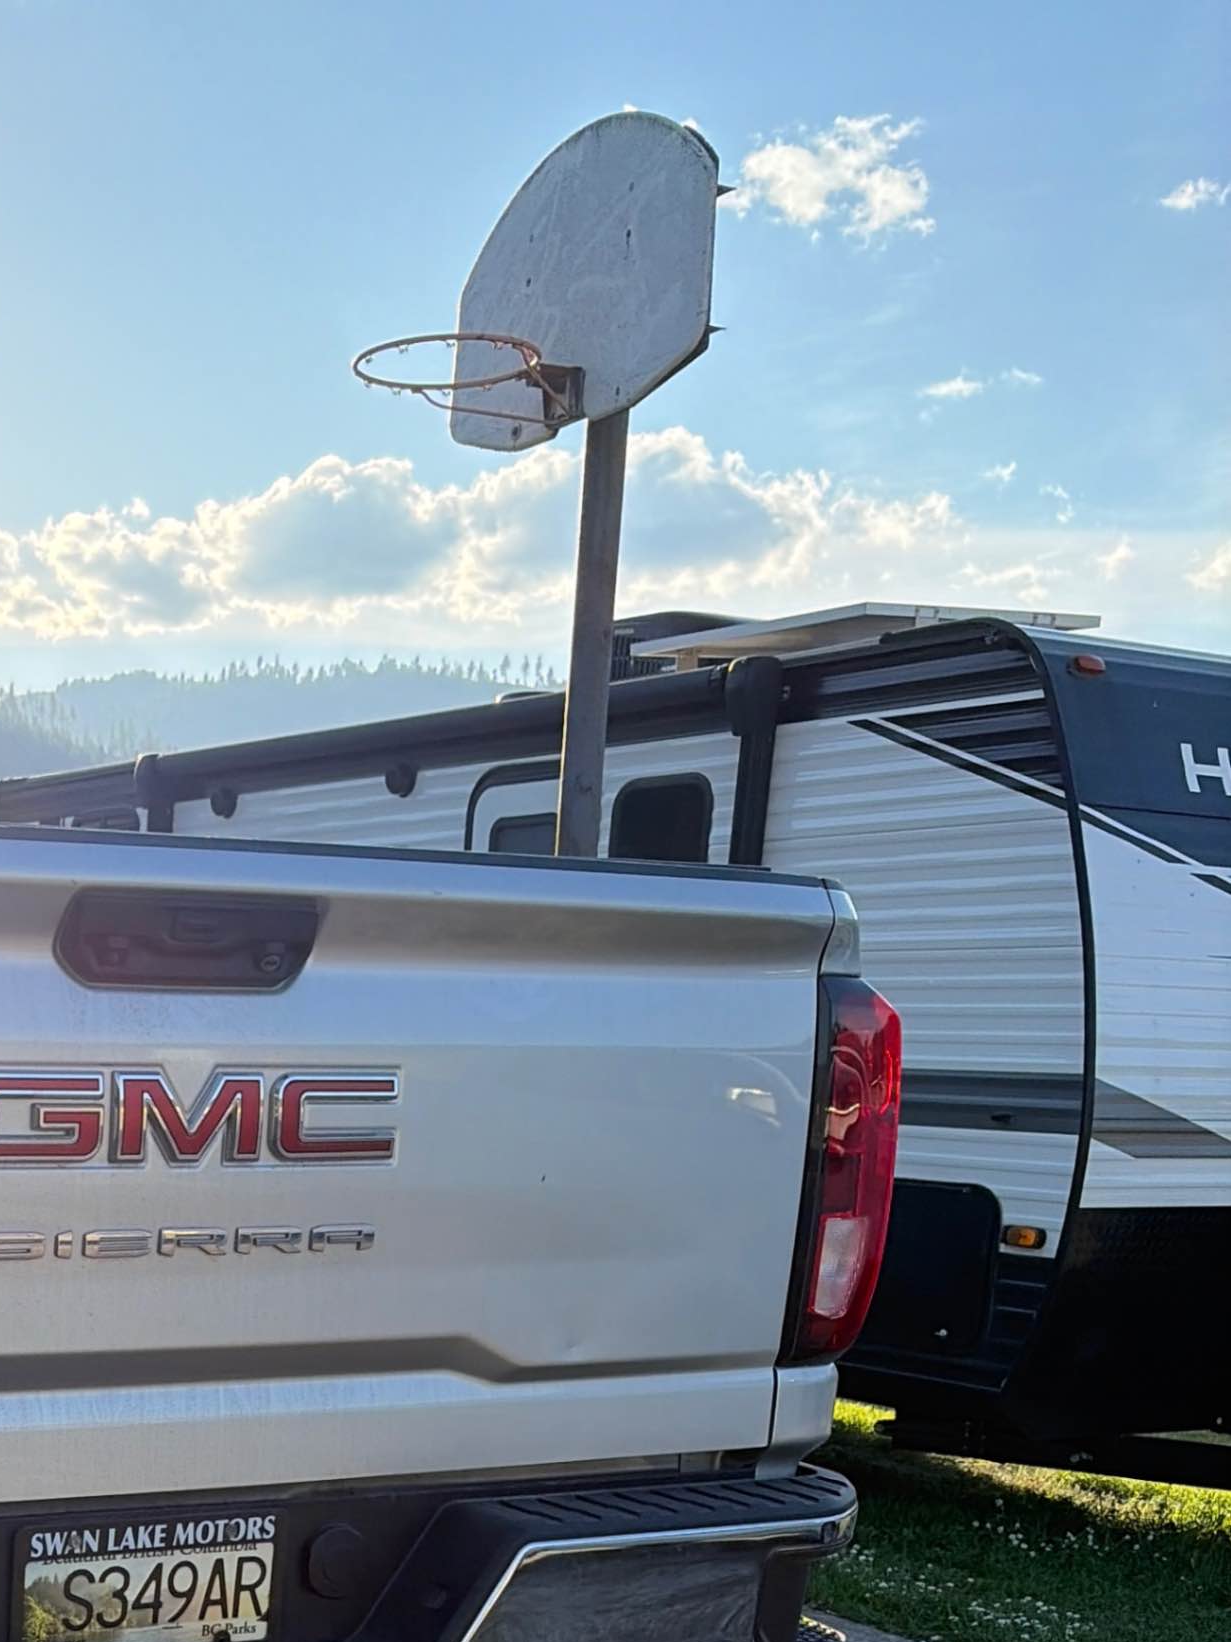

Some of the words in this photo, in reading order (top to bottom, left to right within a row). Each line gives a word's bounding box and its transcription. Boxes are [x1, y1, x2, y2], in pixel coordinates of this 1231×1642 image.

[1180, 743, 1231, 796] H
[30, 1529, 101, 1558] SWAN
[107, 1524, 168, 1551] LAKE
[172, 1515, 276, 1547] MOTORS
[61, 1556, 268, 1632] S349AR
[225, 1621, 257, 1635] Parks
